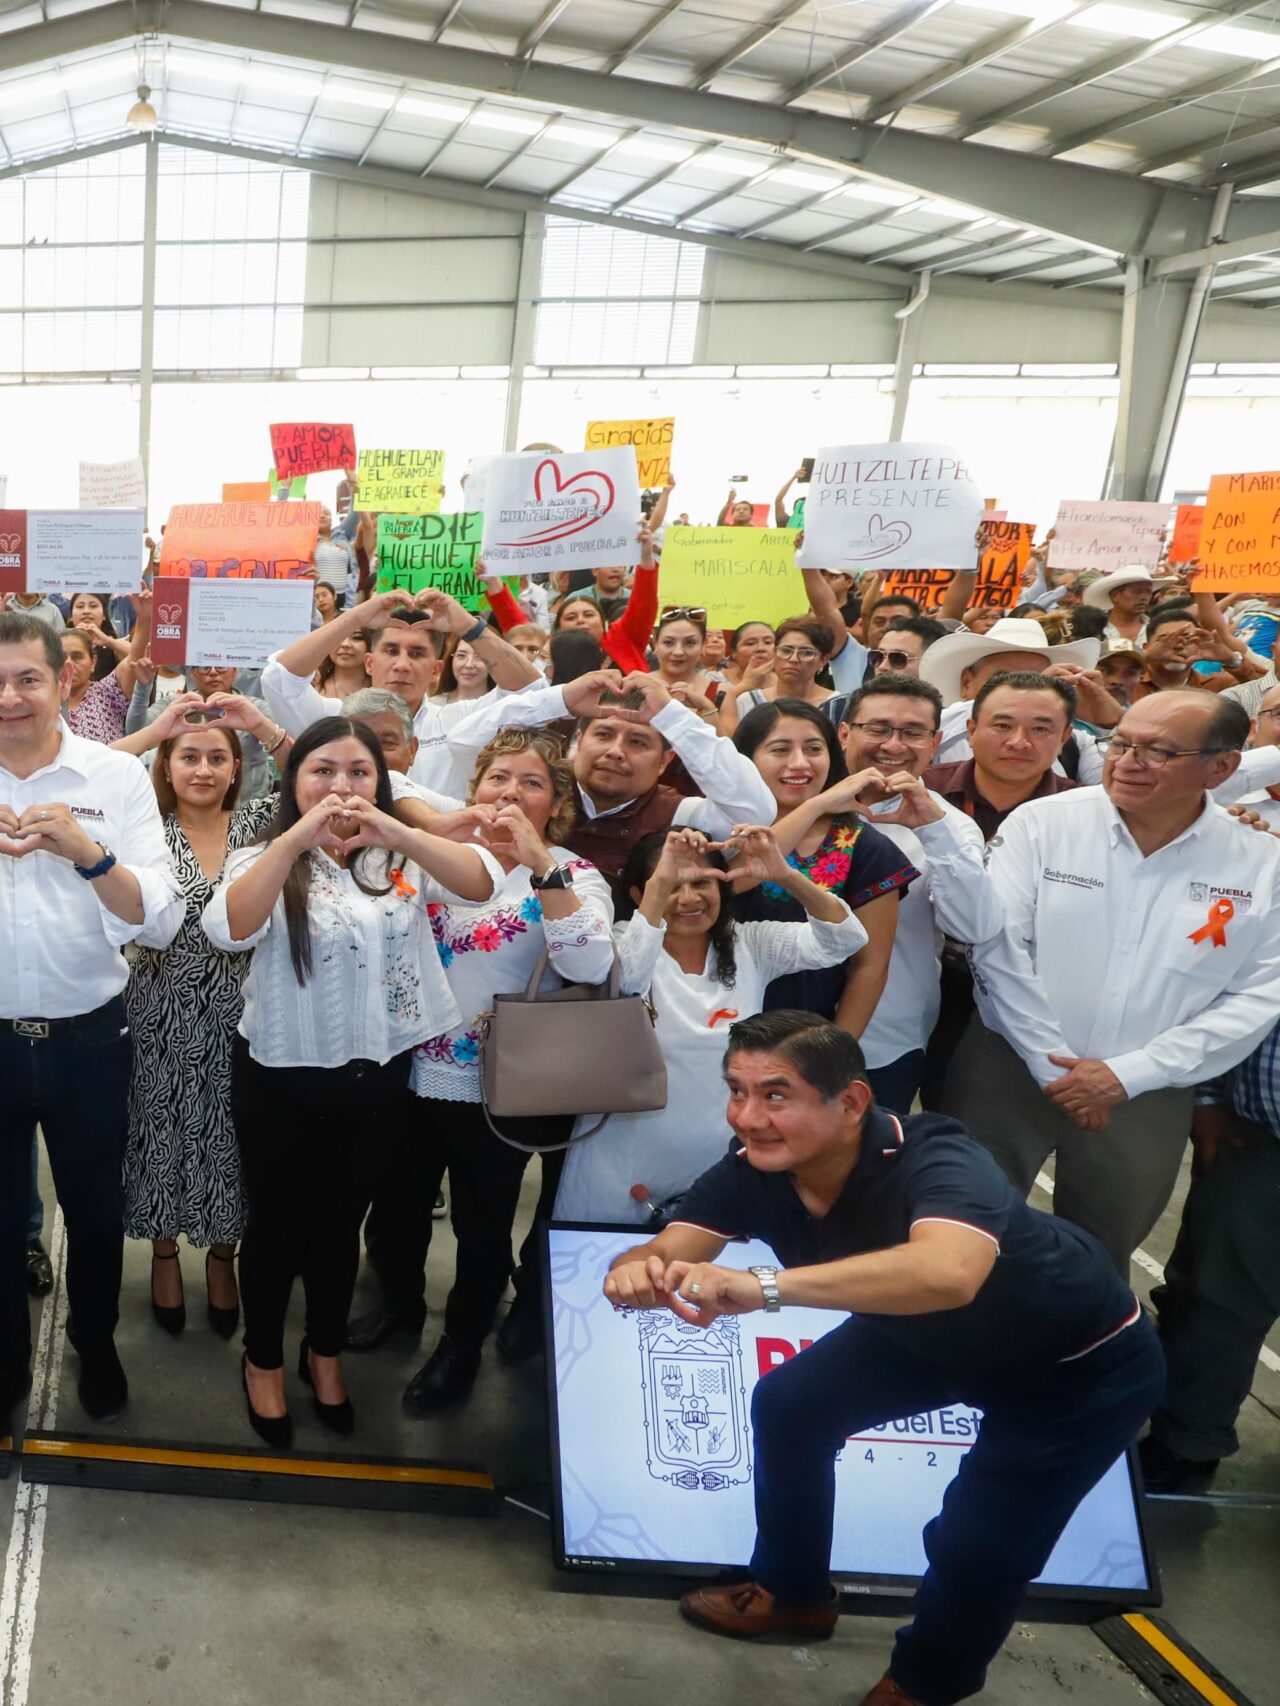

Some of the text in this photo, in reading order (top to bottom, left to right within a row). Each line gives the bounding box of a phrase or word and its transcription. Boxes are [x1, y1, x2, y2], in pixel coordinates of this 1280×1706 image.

[588, 421, 674, 446] Gracias
[275, 441, 354, 469] PUEBLA
[358, 449, 442, 468] HUEHUETLAN
[367, 467, 434, 482] EL GRANDE
[373, 485, 429, 501] AGRADECE
[819, 487, 951, 508] PRESENTE
[170, 501, 321, 528] HUEHUETLAN
[1212, 511, 1245, 530] CON
[419, 512, 481, 542] DIF
[483, 536, 628, 560] POR AMOR A PUEBLA
[1206, 538, 1257, 554] Y CON
[693, 559, 788, 577] MARISCALA
[157, 628, 181, 636] OBRA
[71, 806, 104, 817] PUEBLA
[1043, 867, 1105, 889] Gobernación
[1210, 886, 1253, 899] PUEBLA
